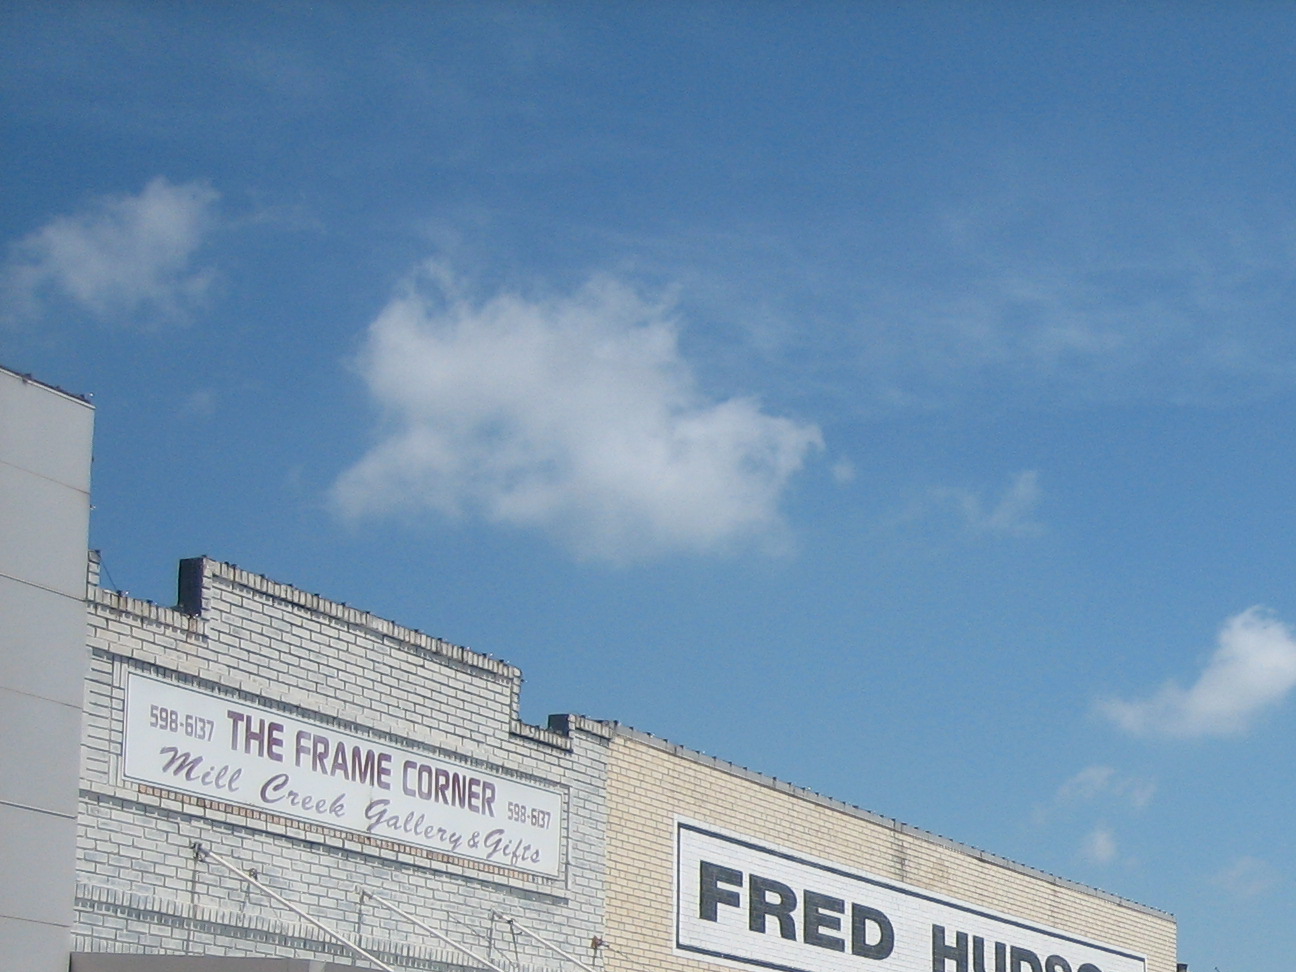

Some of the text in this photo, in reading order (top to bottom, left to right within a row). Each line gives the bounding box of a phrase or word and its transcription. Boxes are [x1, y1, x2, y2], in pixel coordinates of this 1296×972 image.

[150, 704, 214, 742] 598-6137
[227, 710, 284, 763] THE
[295, 730, 392, 791] FRAME
[402, 760, 496, 817] CORNER
[160, 746, 541, 866] Mill Creek Gallery & Gifts
[700, 860, 895, 961] FRED
